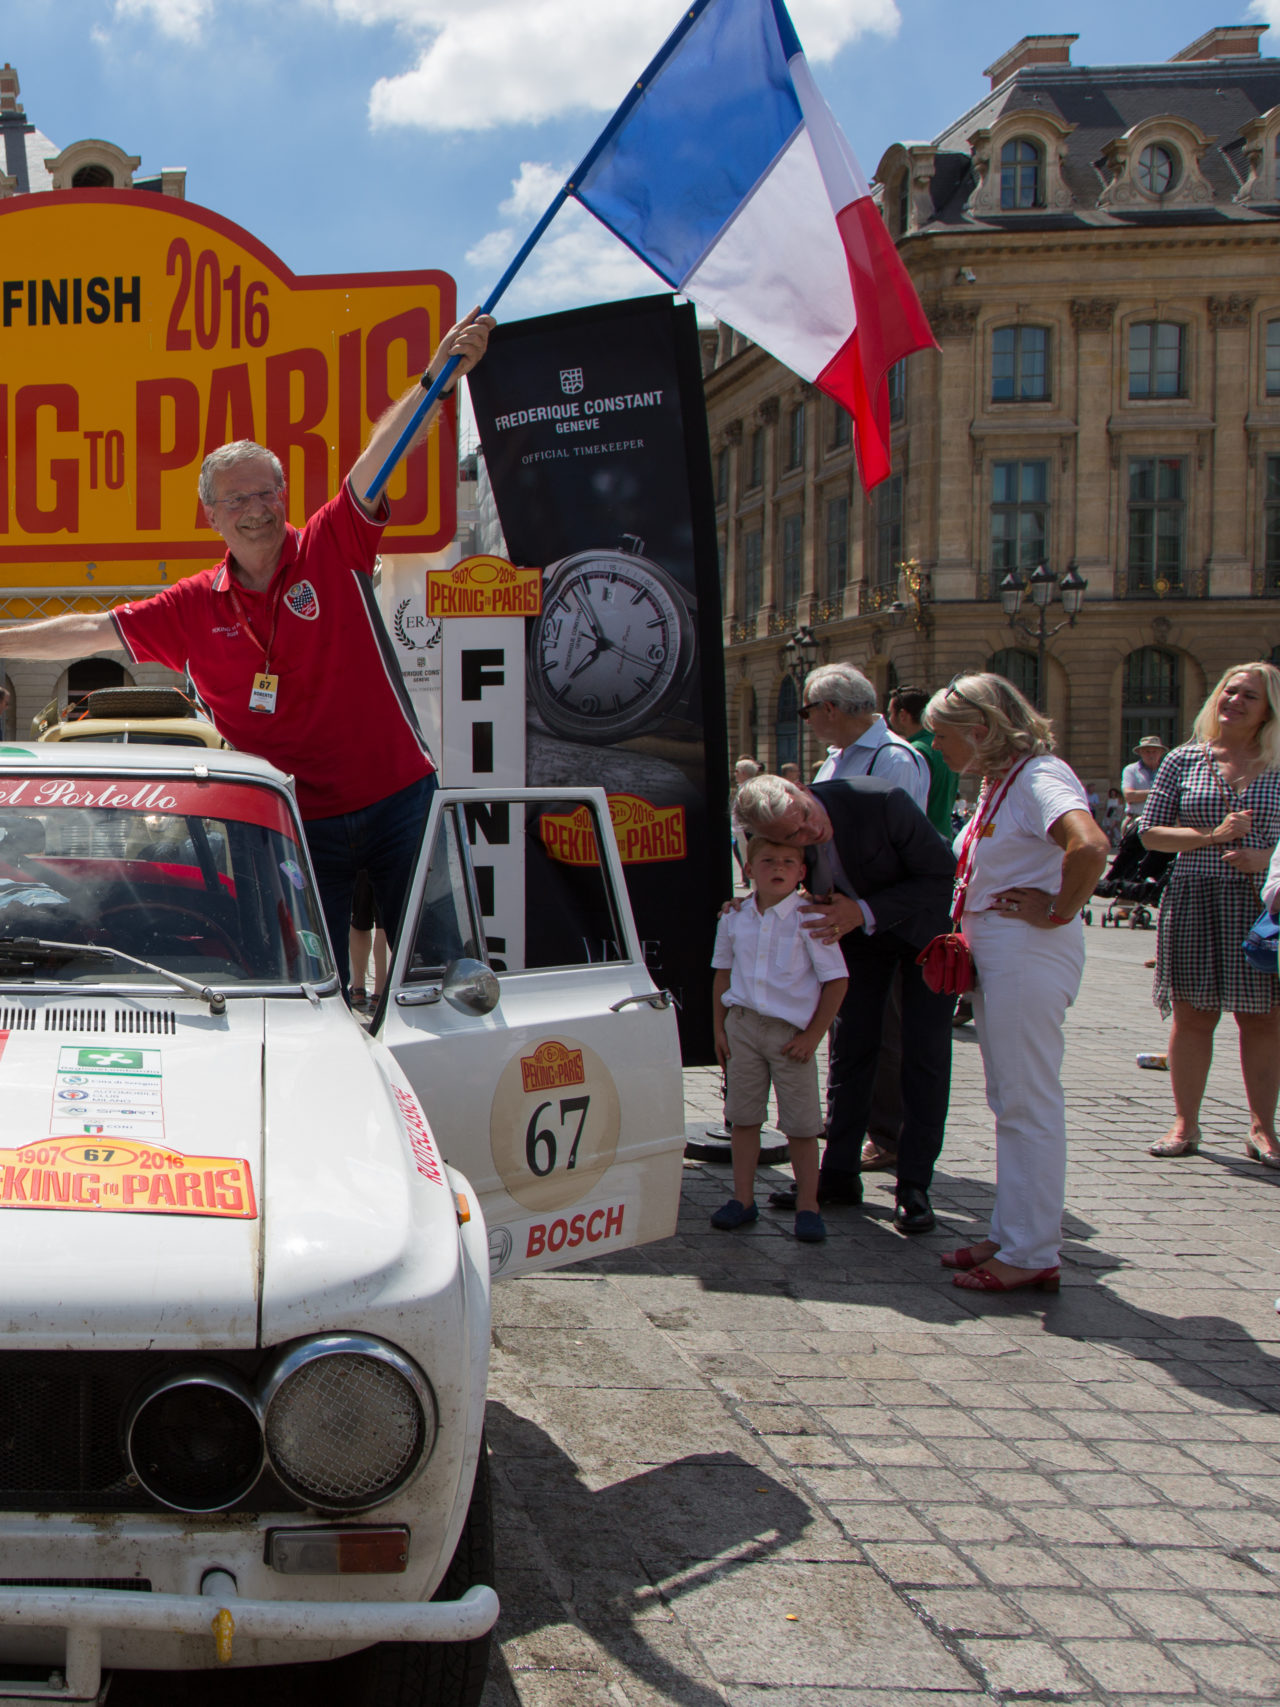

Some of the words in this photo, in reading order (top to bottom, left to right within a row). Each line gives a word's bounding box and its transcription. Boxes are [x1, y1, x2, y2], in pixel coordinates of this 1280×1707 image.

[3, 276, 141, 327] FINISH
[166, 238, 270, 351] 2016
[84, 430, 125, 490] TO
[136, 307, 430, 530] PARIS
[495, 402, 580, 431] FREDERIQUE
[584, 391, 663, 415] CONSTANT
[555, 418, 600, 434] GENEVE
[521, 447, 569, 465] OFFICIAL
[573, 439, 645, 457] TIMEKEEPER
[451, 567, 469, 584] 1907
[499, 566, 517, 584] 2016
[430, 580, 484, 613] PEKING
[492, 579, 538, 612] PARIS
[406, 616, 436, 629] ERA
[543, 618, 562, 649] 12
[259, 681, 271, 690] 67
[34, 780, 177, 809] Portello
[573, 810, 592, 828] 190
[632, 803, 655, 824] 2016
[545, 820, 599, 861] PEKIN
[626, 812, 682, 858] PARIS
[523, 1061, 555, 1090] PEKING
[558, 1053, 583, 1083] PARIS
[525, 1095, 591, 1177] 67
[15, 1146, 61, 1167] 1907
[84, 1149, 116, 1162] 67
[138, 1150, 185, 1170] 2016
[123, 1168, 244, 1210] PARIS
[526, 1204, 625, 1258] BOSCH
